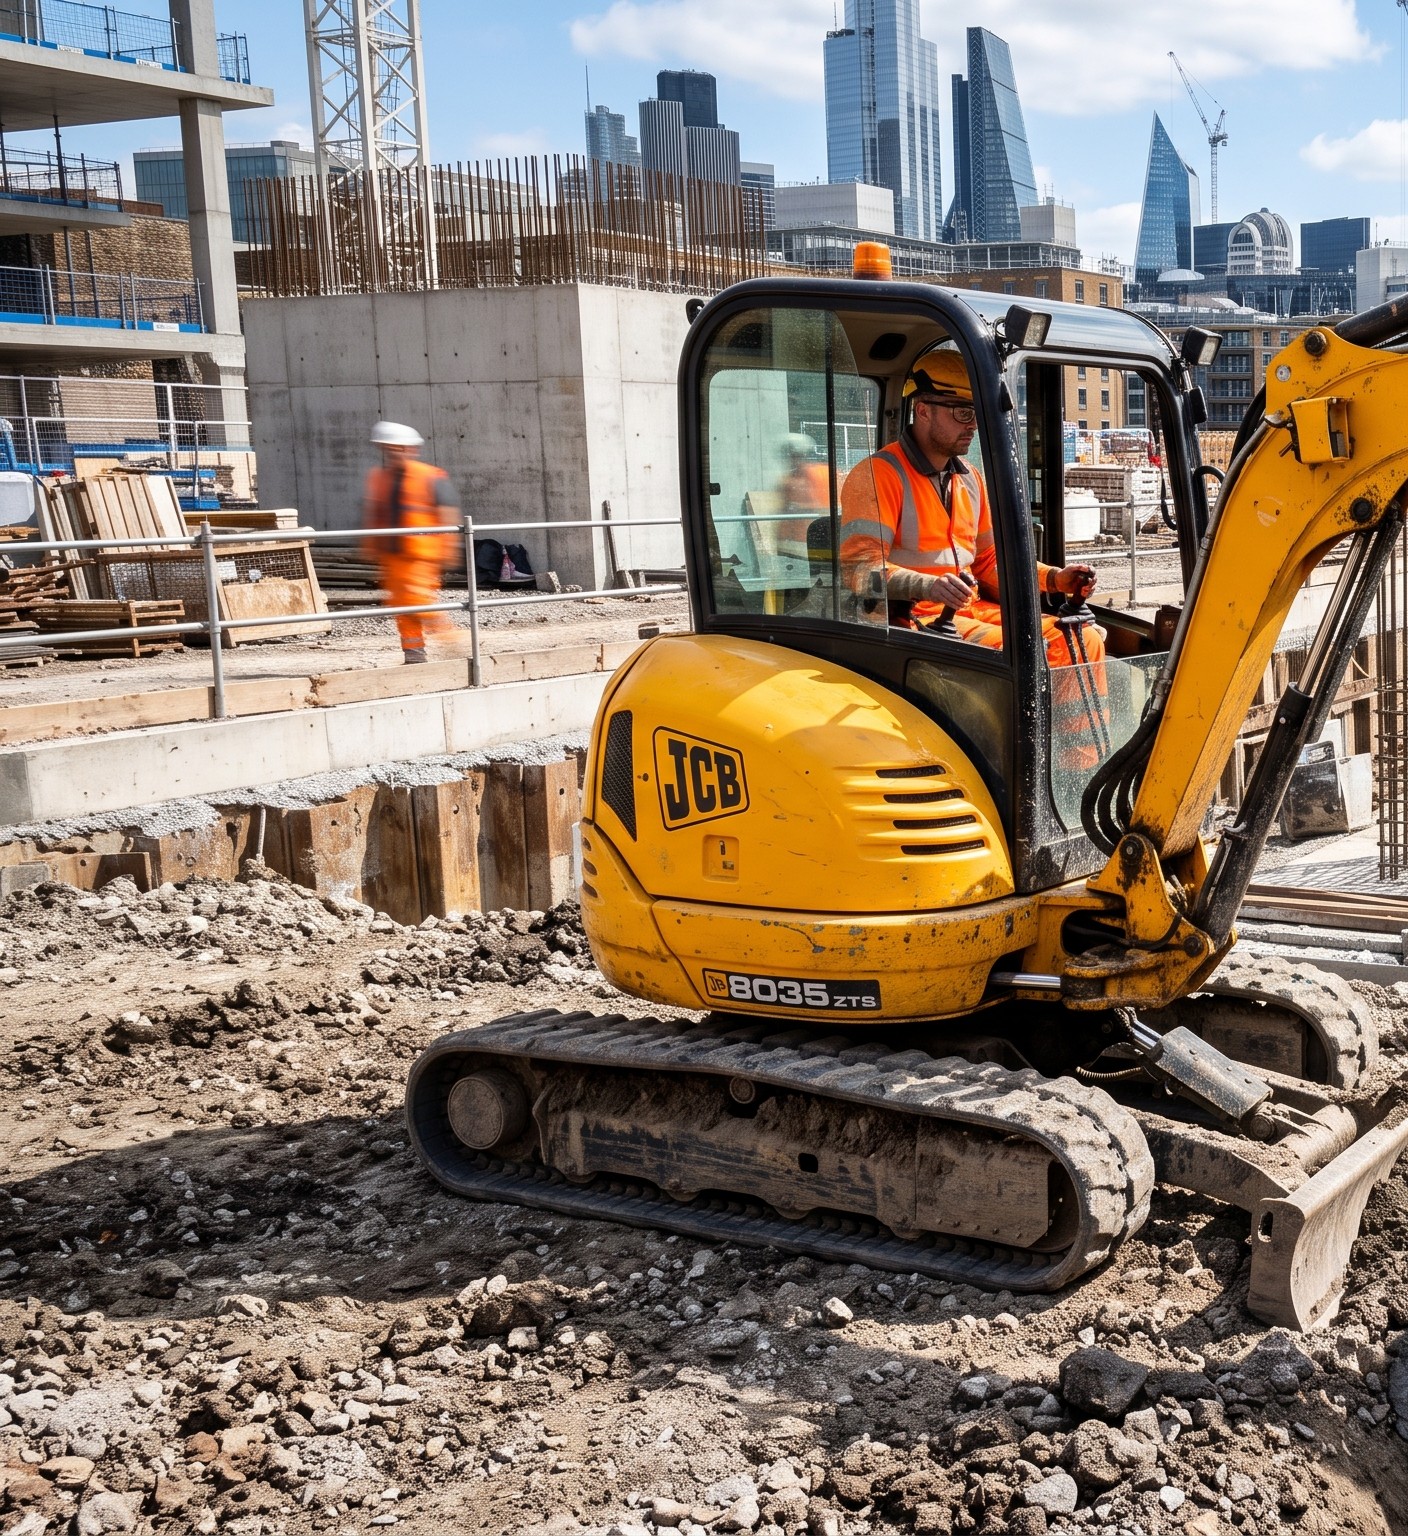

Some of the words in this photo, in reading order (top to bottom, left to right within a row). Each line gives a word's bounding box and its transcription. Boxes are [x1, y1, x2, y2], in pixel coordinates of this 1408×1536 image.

[664, 738, 741, 821] JCB
[728, 975, 830, 1007] 8035
[833, 995, 877, 1008] ZTS
